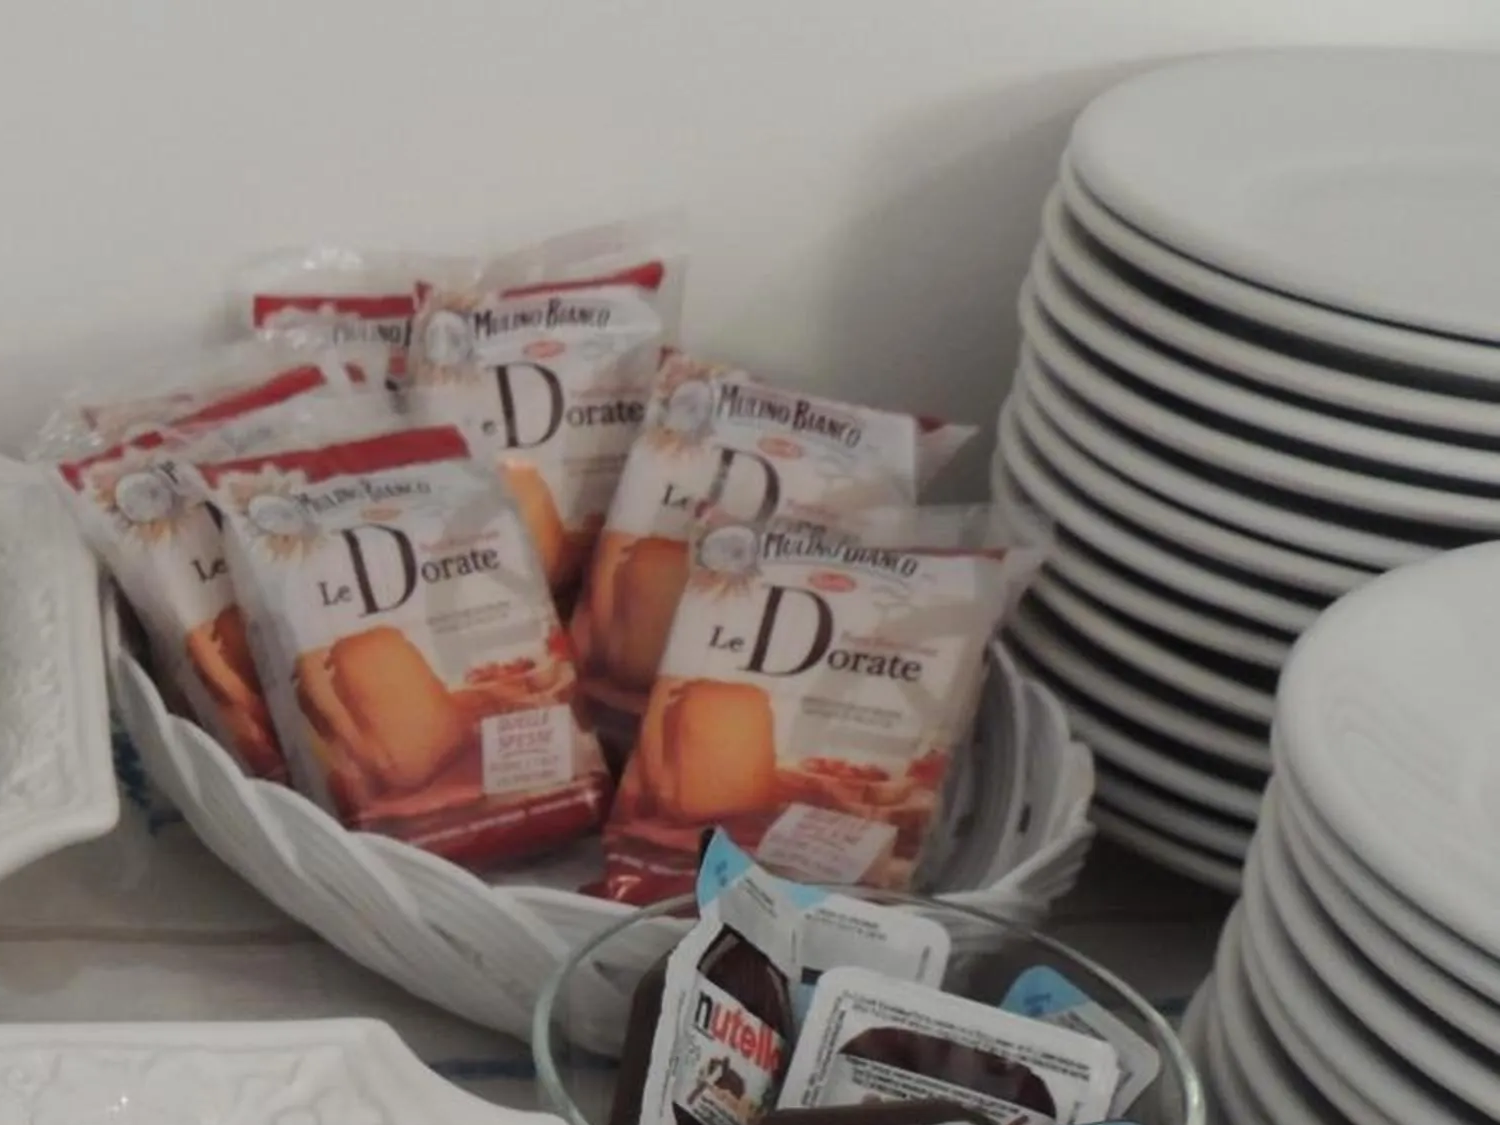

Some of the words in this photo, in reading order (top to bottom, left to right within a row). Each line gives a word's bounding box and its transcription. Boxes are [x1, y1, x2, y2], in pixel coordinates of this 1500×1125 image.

[486, 361, 646, 449] Dorate
[317, 581, 352, 606] Le
[330, 523, 500, 619] Dorate
[709, 625, 745, 651] Le
[737, 582, 922, 682] Dorate
